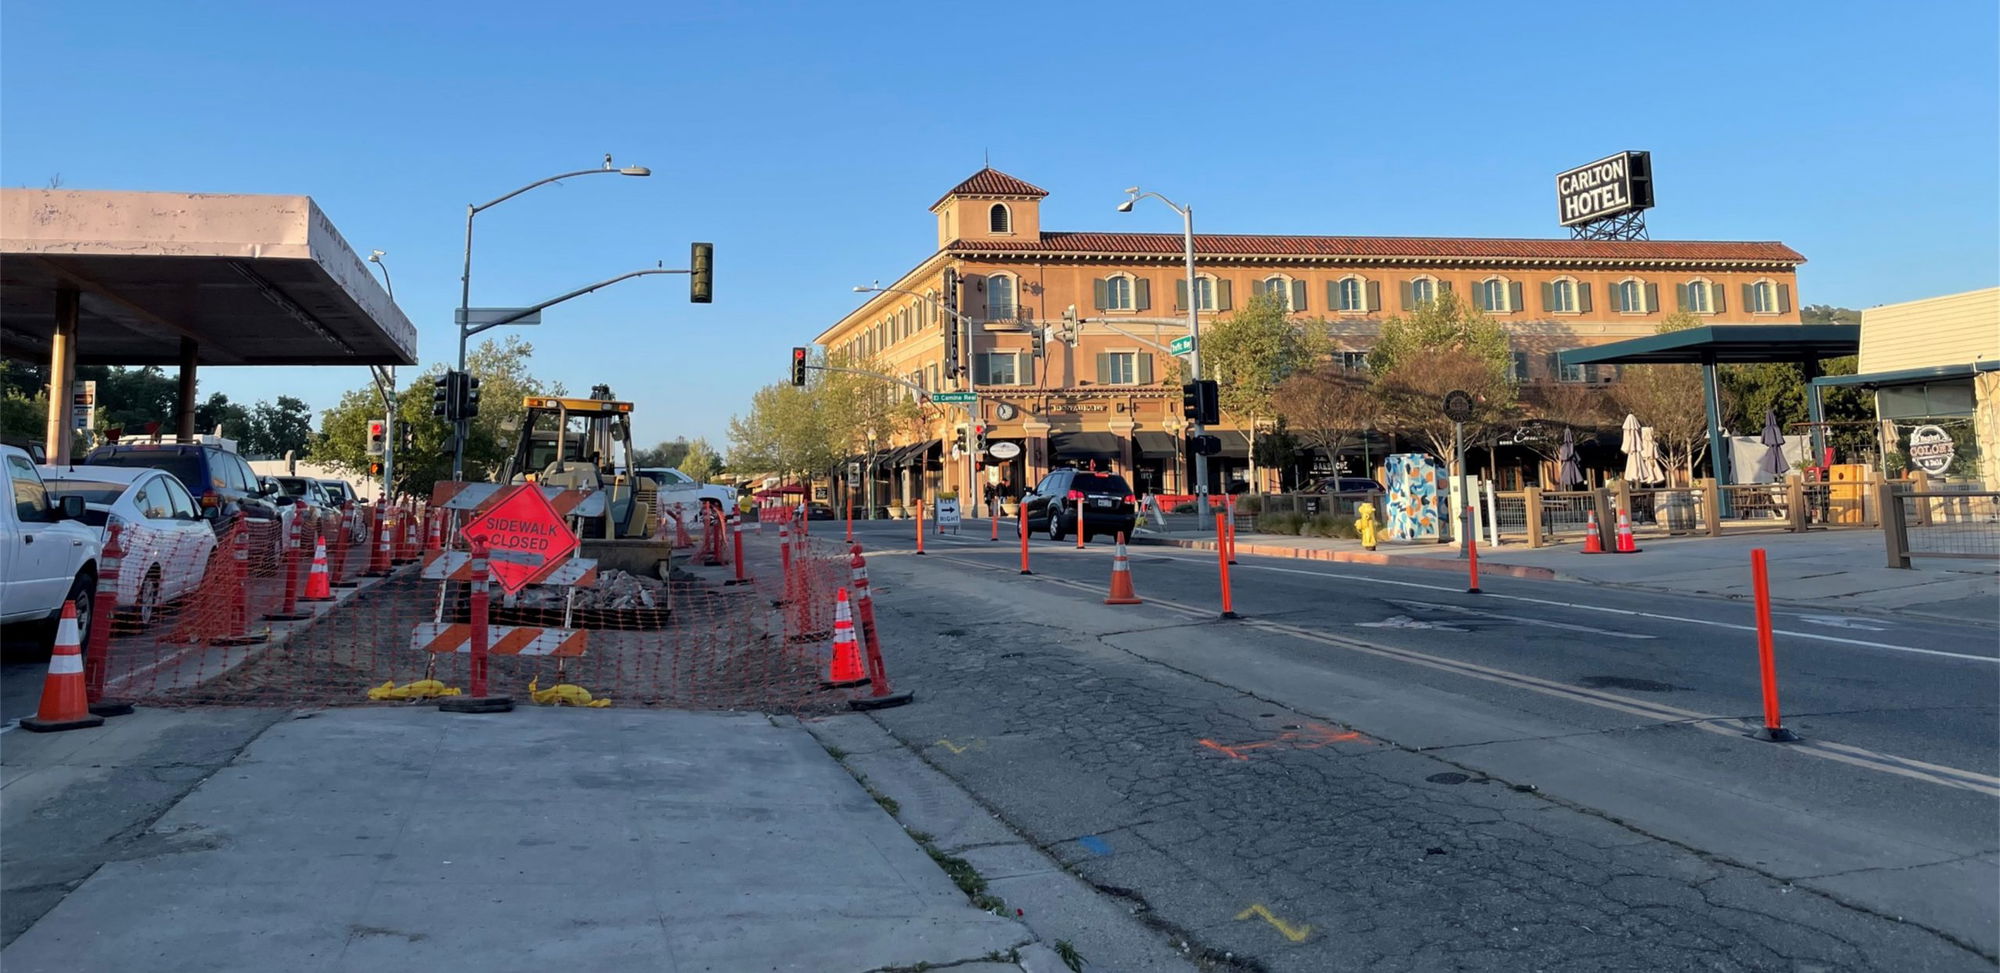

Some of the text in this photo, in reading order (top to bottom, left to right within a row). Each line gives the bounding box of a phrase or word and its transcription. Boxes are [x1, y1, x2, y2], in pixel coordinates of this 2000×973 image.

[1560, 159, 1624, 195] CARLTON
[1565, 182, 1626, 219] HOTEL
[486, 518, 558, 537] SIDEWALK
[490, 533, 549, 551] CLOSED
